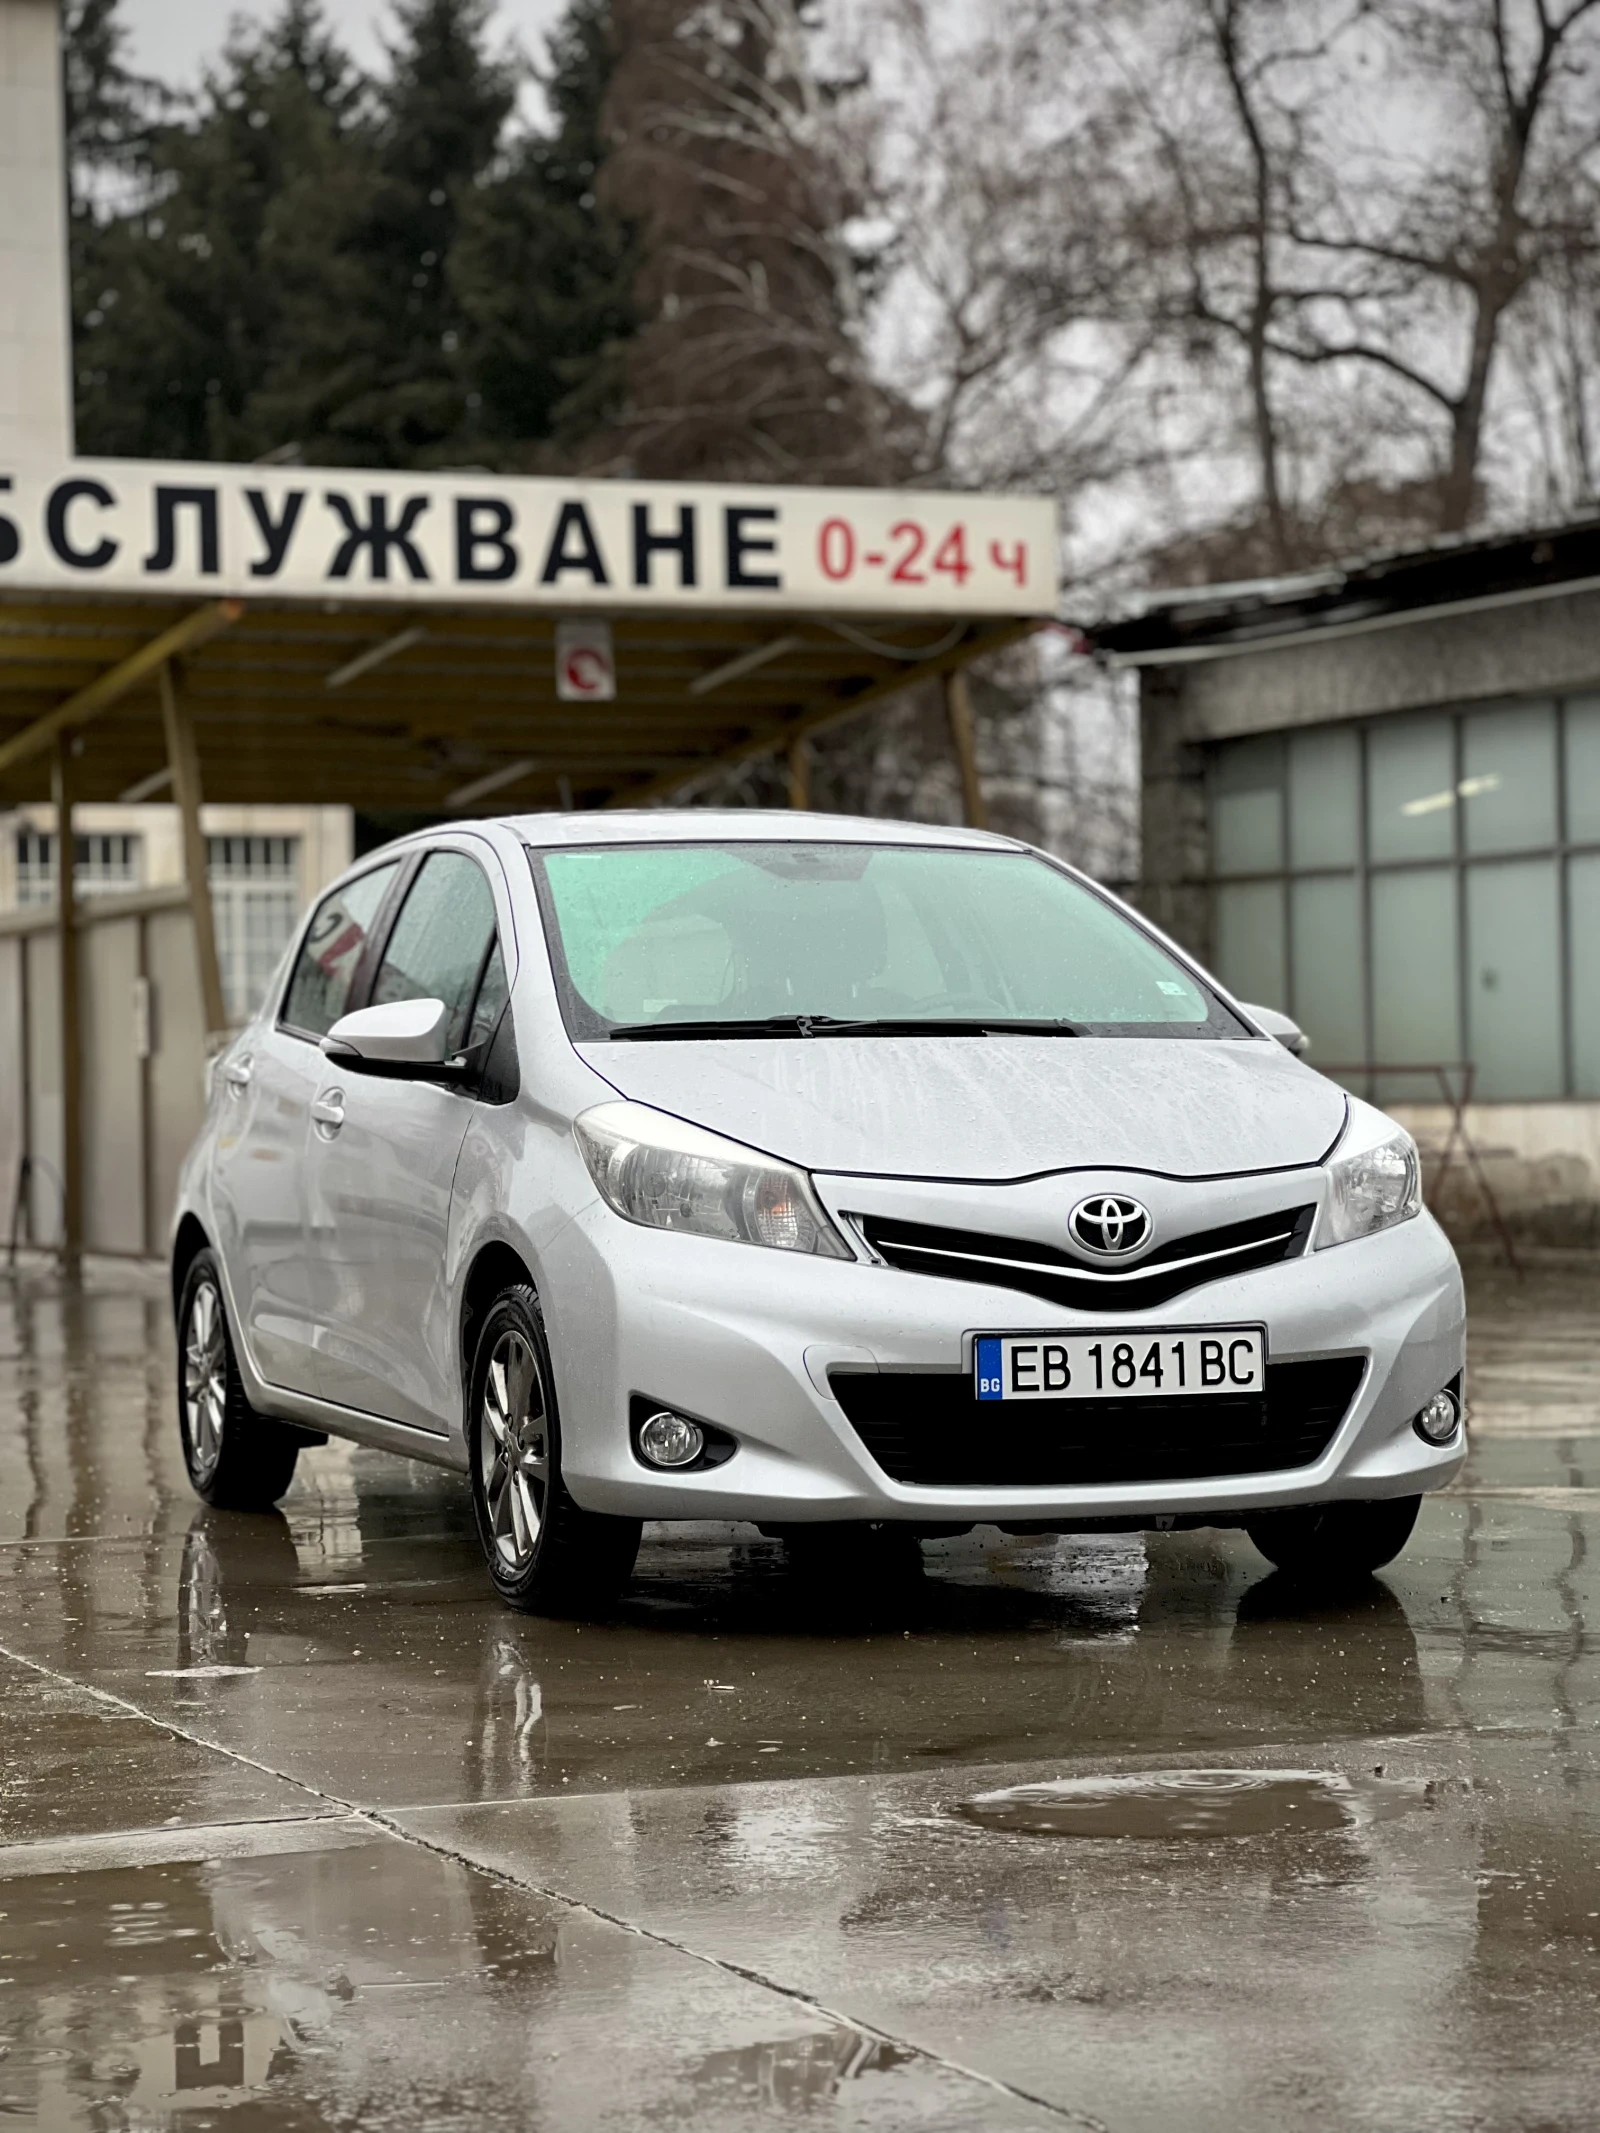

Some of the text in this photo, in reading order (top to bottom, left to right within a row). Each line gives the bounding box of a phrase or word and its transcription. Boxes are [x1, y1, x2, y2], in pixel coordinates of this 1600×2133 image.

[818, 516, 972, 585] 0-24
[980, 1378, 1001, 1393] BG
[1010, 1339, 1255, 1393] EB 1841 BC
